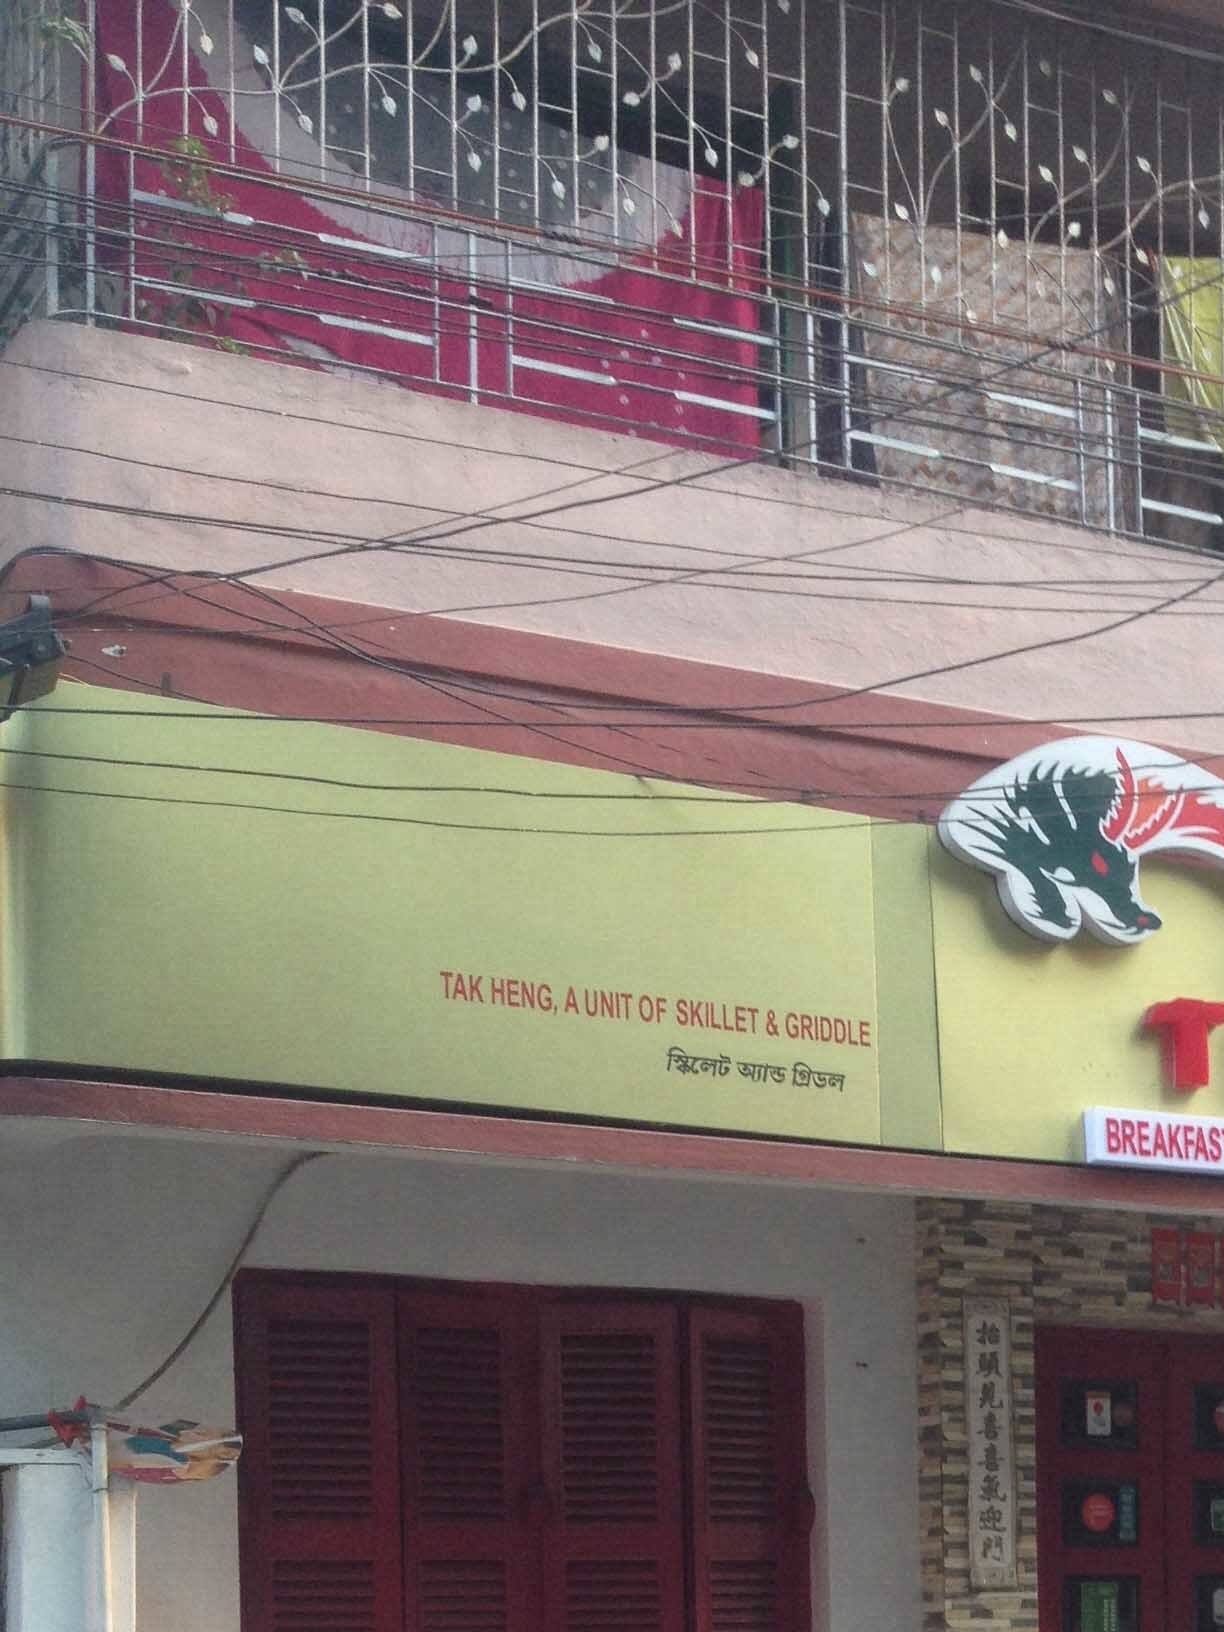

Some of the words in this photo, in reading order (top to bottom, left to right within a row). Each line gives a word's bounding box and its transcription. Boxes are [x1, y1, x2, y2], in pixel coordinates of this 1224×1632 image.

[440, 971, 484, 1003] TAK
[491, 977, 558, 1017] HENG,
[564, 986, 580, 1015] A
[585, 989, 633, 1022] UNIT
[638, 994, 668, 1024] OF
[676, 999, 759, 1035] SKILLET
[766, 1011, 780, 1037] &
[785, 1013, 871, 1048] GRIDDLE
[792, 1061, 846, 1092] গ্রিডল
